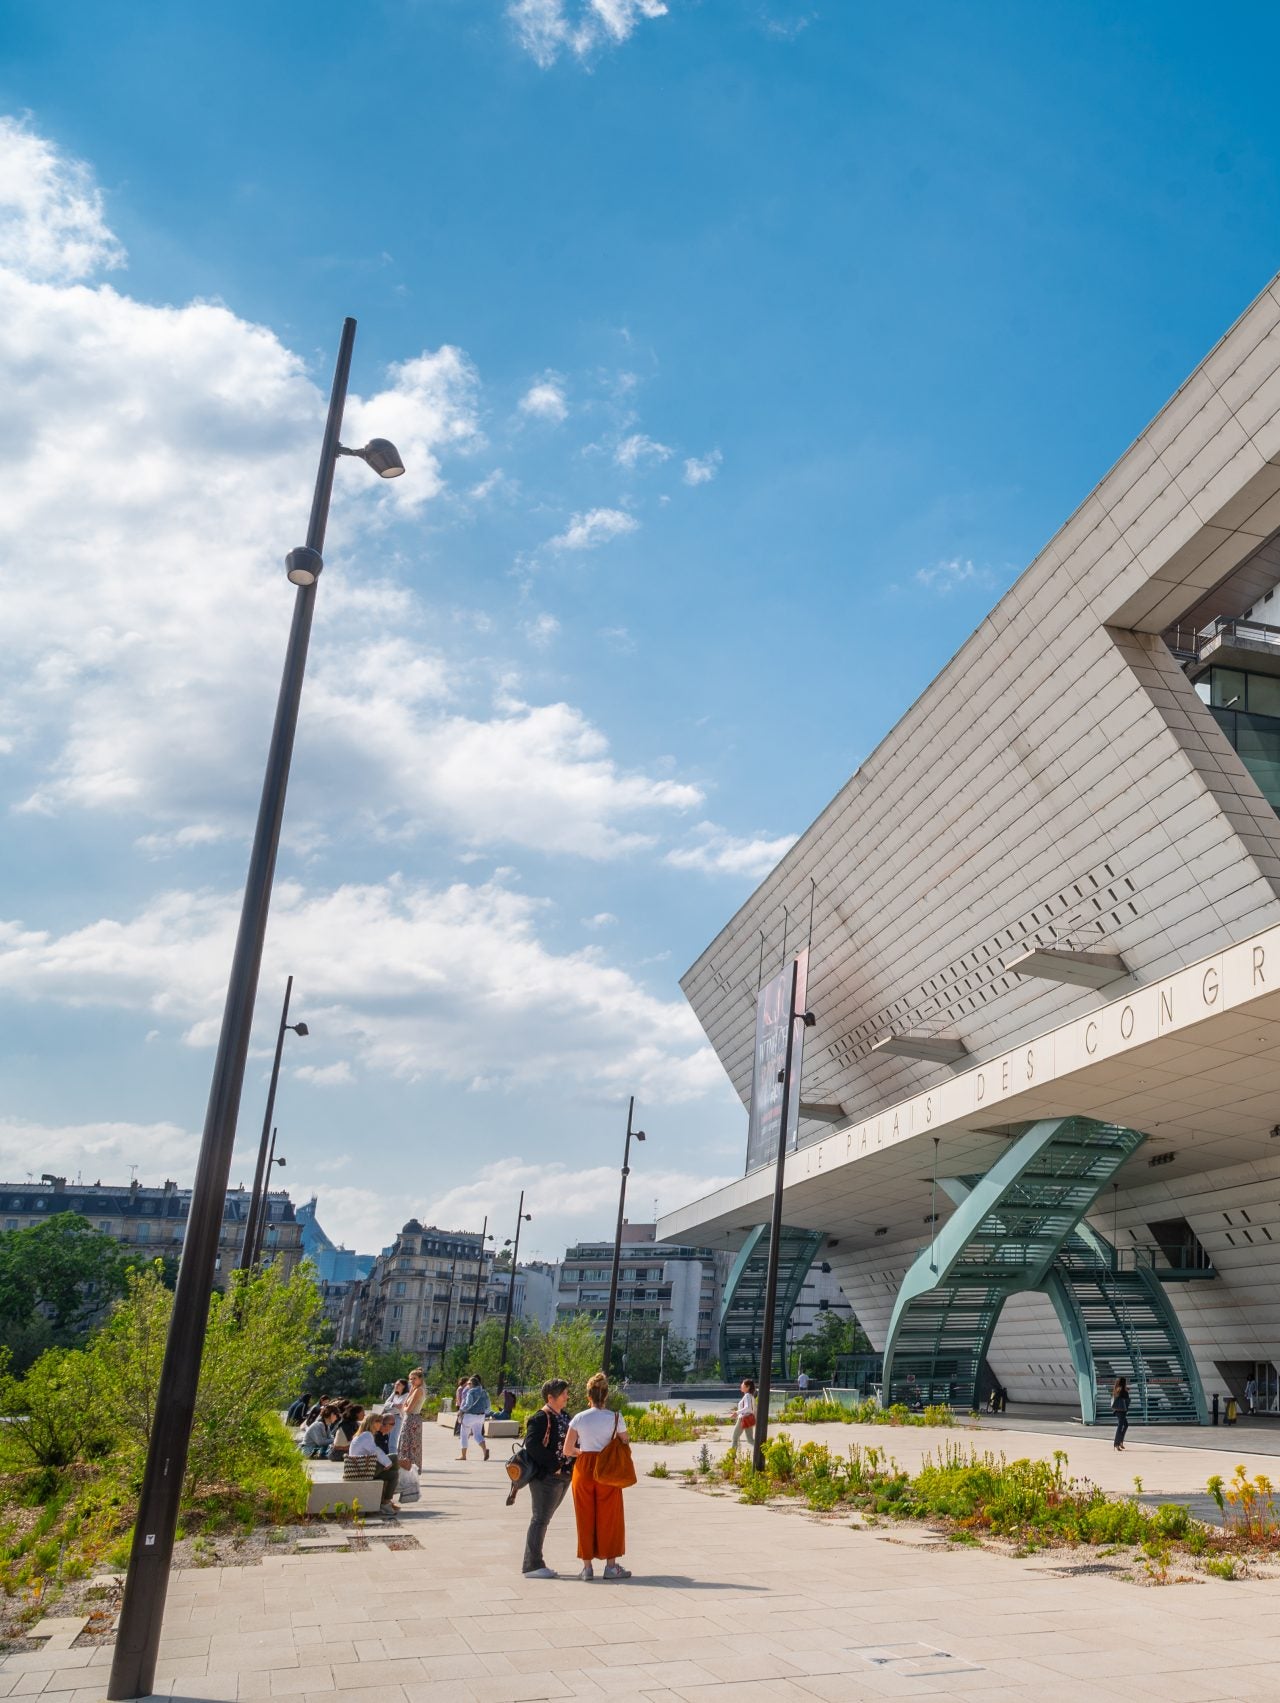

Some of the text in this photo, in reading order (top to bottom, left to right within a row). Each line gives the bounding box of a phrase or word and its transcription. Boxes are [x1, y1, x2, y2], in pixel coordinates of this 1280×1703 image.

[806, 1146, 823, 1173] LE
[846, 1096, 933, 1158] PALAIS
[976, 1049, 1035, 1102] DES
